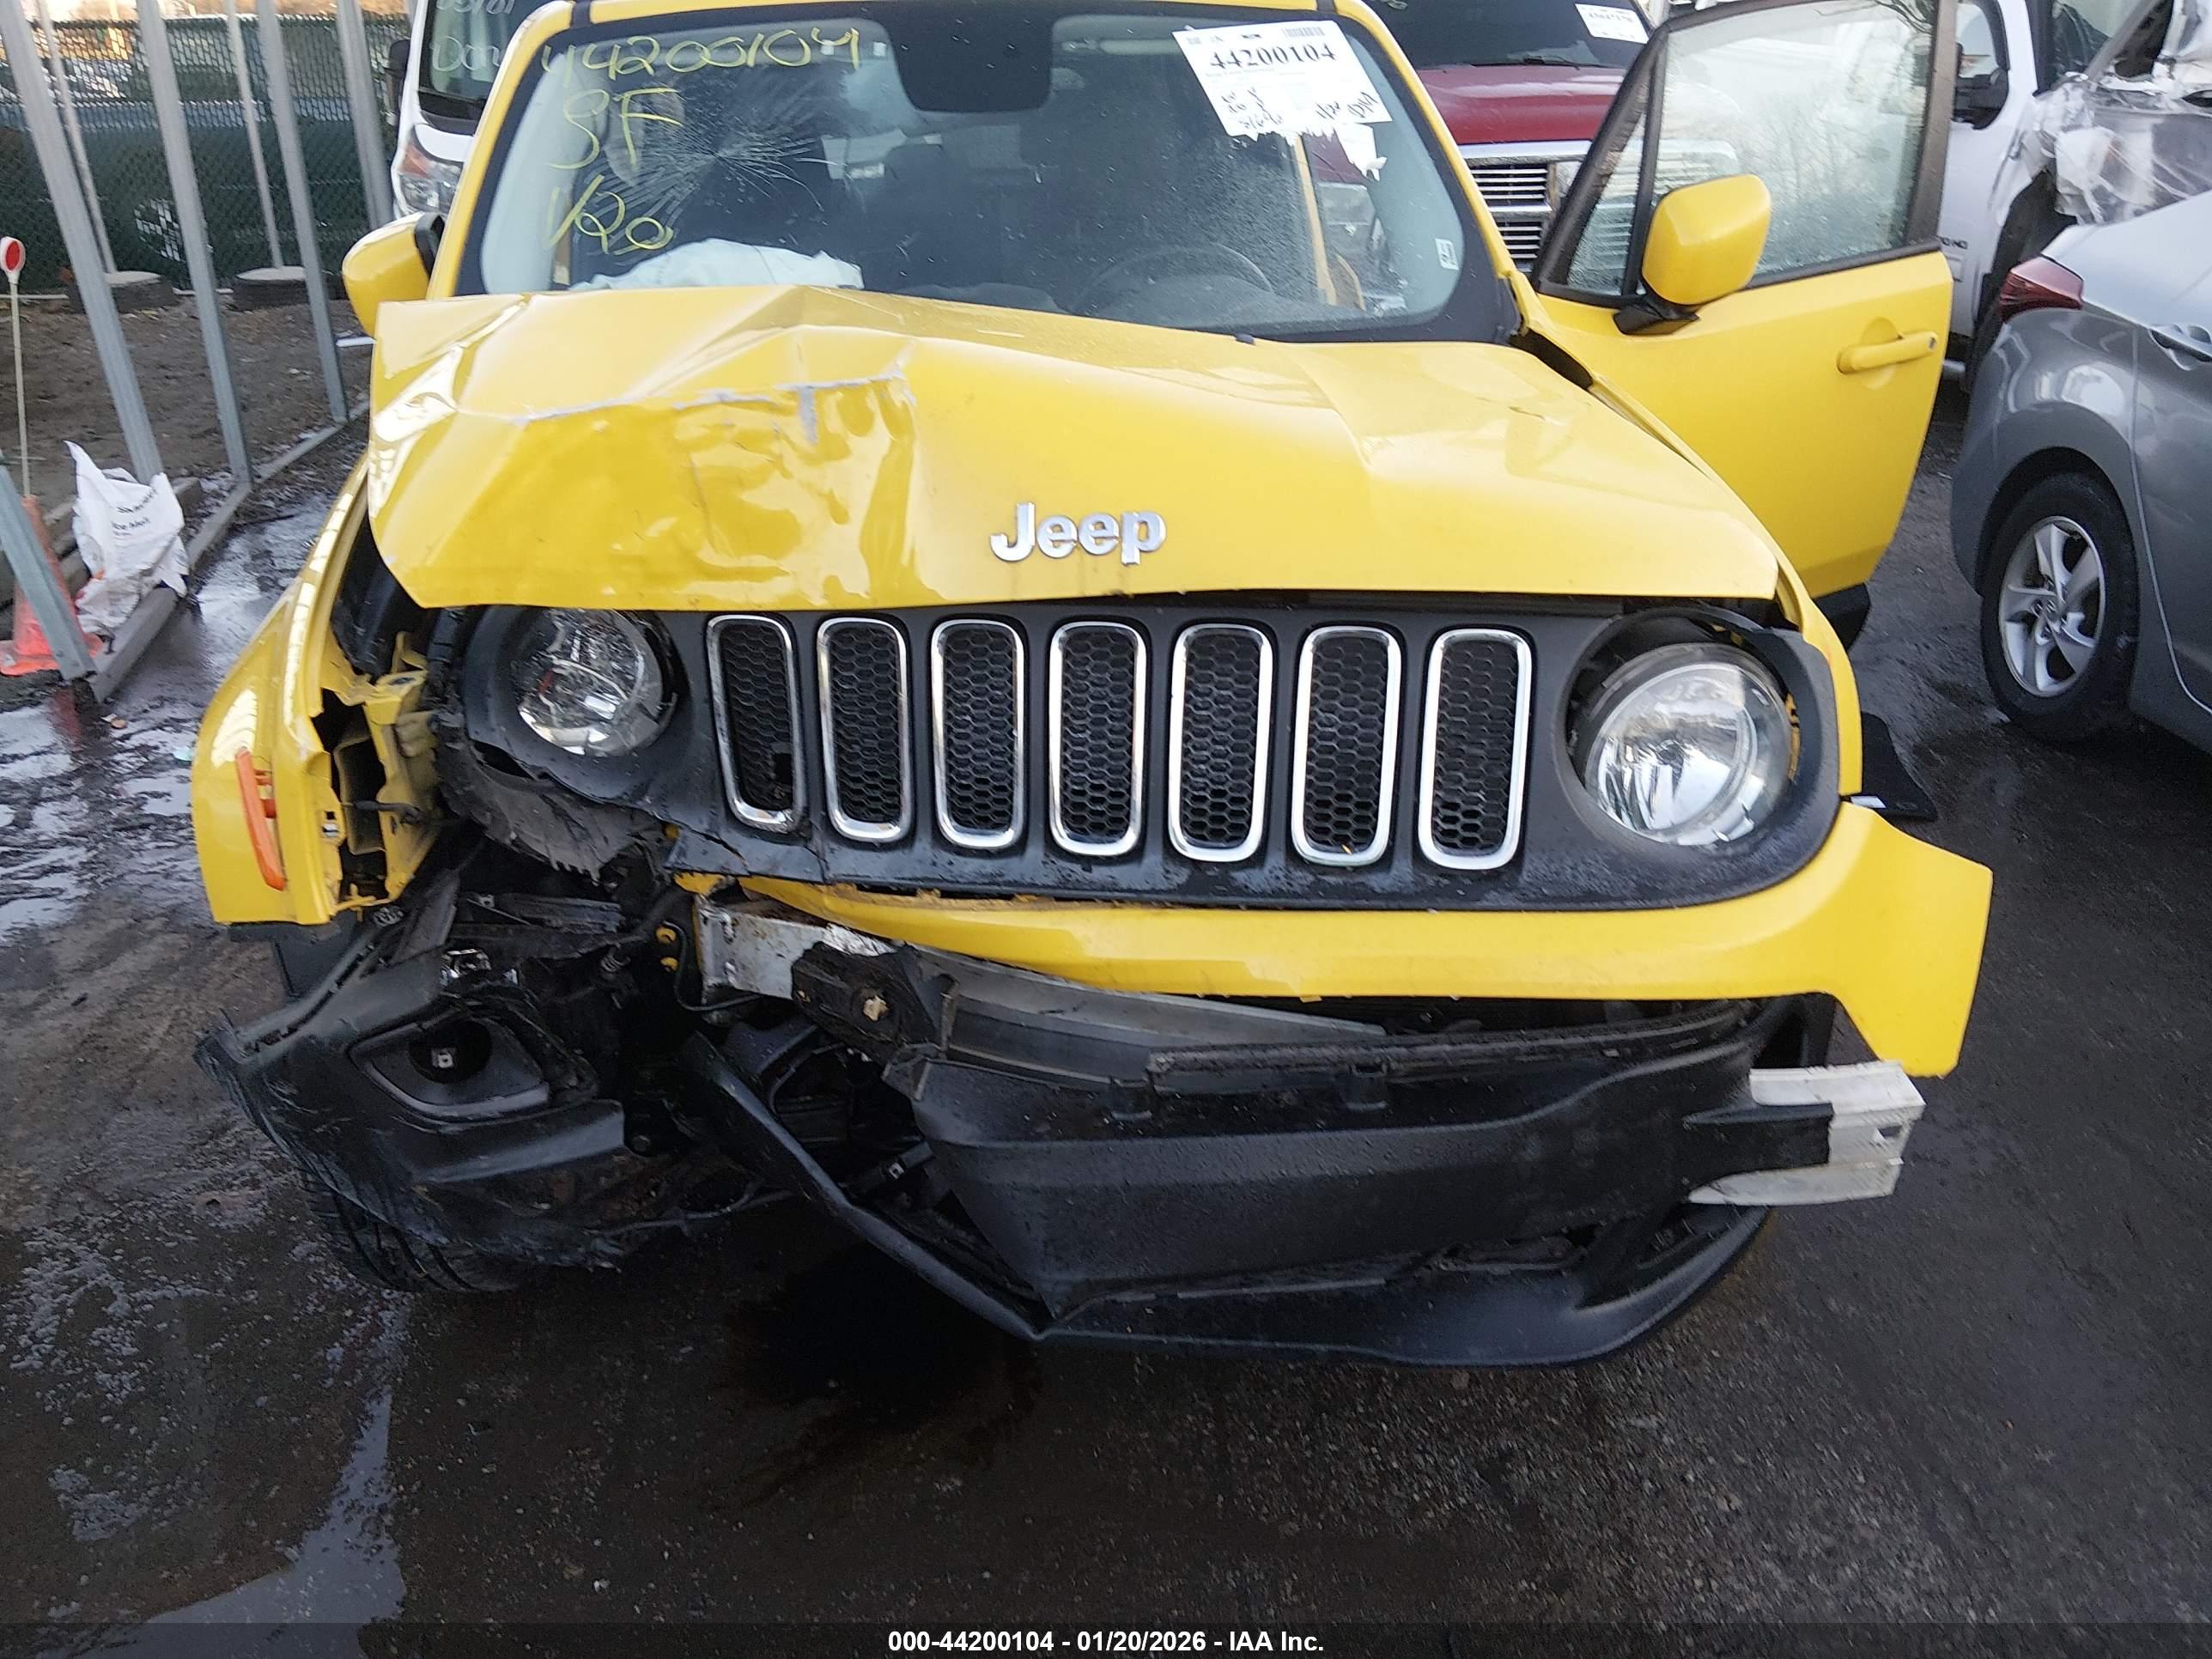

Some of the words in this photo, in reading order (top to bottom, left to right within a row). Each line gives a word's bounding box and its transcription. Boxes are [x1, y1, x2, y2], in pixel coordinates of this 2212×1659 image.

[542, 27, 860, 88] 44200104
[1208, 43, 1337, 70] 44200104
[989, 501, 1167, 567] Jeep
